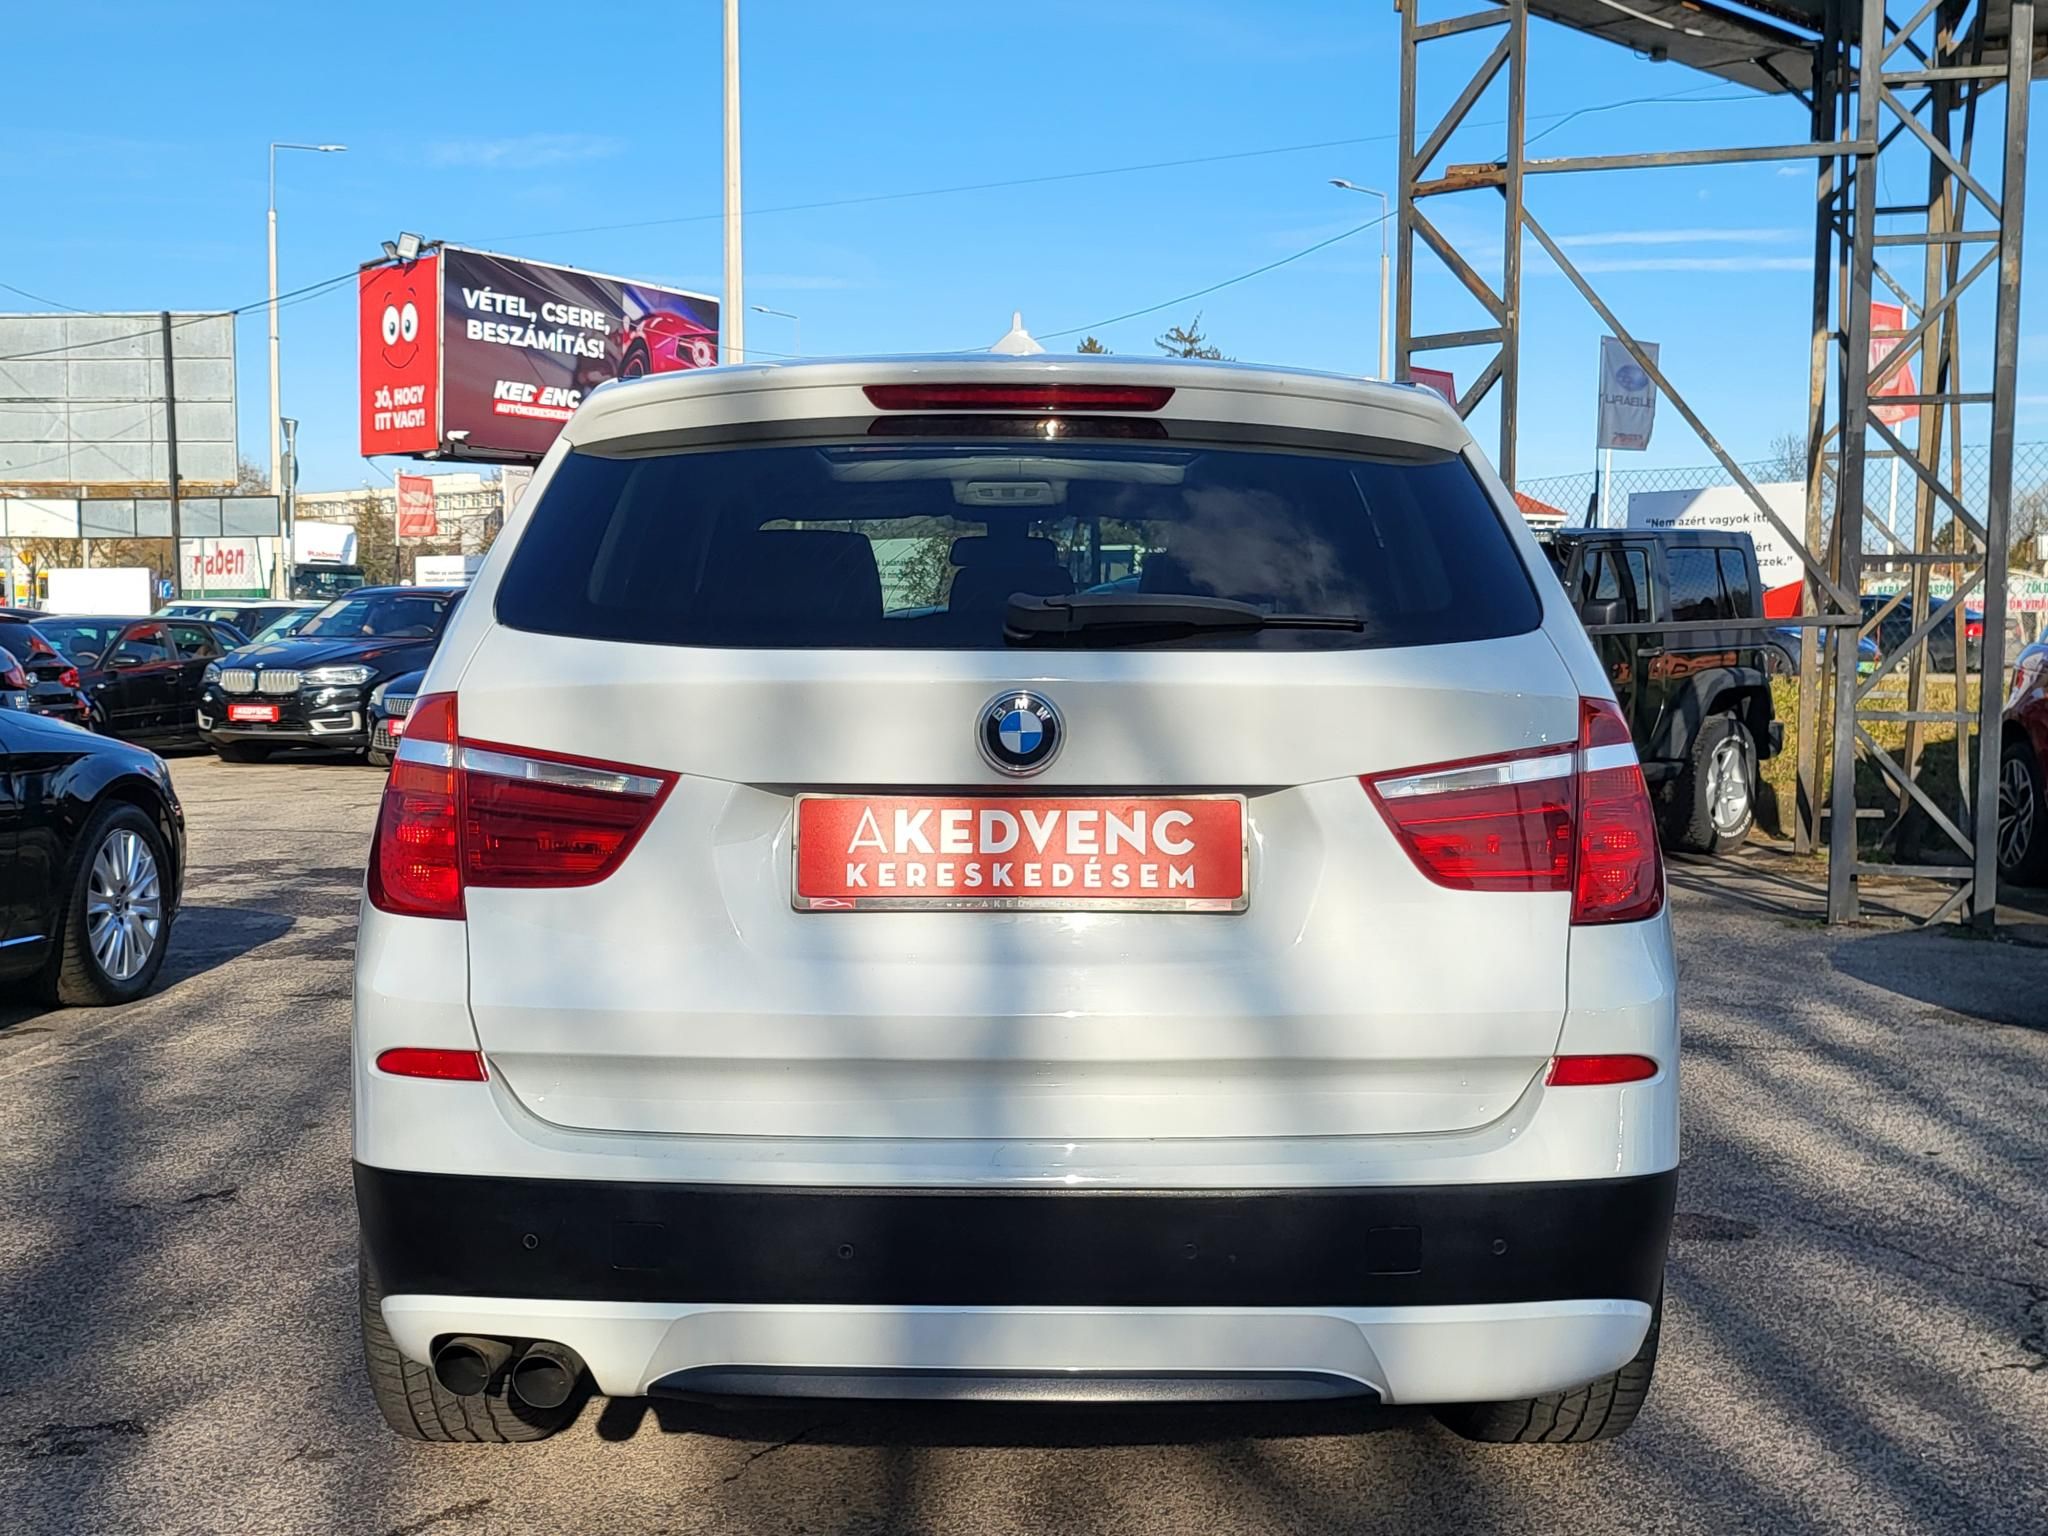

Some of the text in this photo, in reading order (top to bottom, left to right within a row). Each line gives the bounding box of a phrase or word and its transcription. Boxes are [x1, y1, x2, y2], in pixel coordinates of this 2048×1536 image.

[462, 286, 611, 336] VÉTEL, CSERE,
[466, 319, 606, 360] BESZÁMÍTÁS!
[374, 384, 426, 410] JÓ, HOGY
[374, 408, 426, 431] ITT VAGY!
[1678, 515, 1706, 527] azért
[1709, 513, 1750, 527] vagyok
[992, 697, 1051, 721] BMW
[847, 805, 1196, 856] AKEDVENC
[846, 856, 1196, 889] KERESKEDÉSEM
